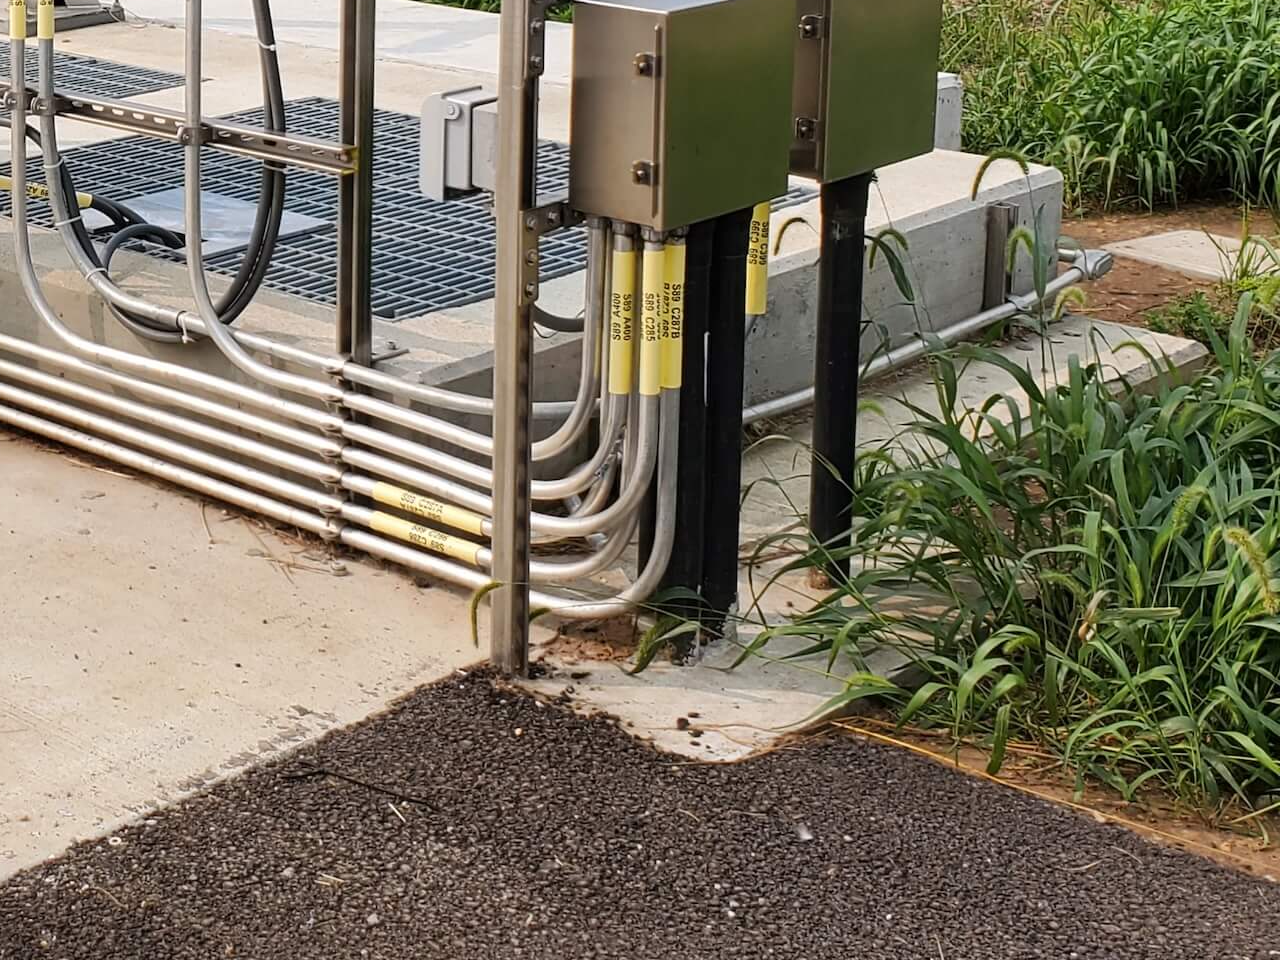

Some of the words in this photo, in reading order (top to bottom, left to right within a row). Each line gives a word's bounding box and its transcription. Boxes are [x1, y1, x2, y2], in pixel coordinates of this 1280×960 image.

[750, 220, 761, 244] C399
[749, 248, 758, 265] S89
[623, 294, 632, 312] S89
[645, 292, 654, 311] S89
[671, 284, 681, 302] S89
[612, 293, 621, 318] A400
[612, 322, 621, 341] S89
[623, 317, 632, 341] A400
[645, 316, 656, 342] C285
[671, 307, 681, 339] C287B
